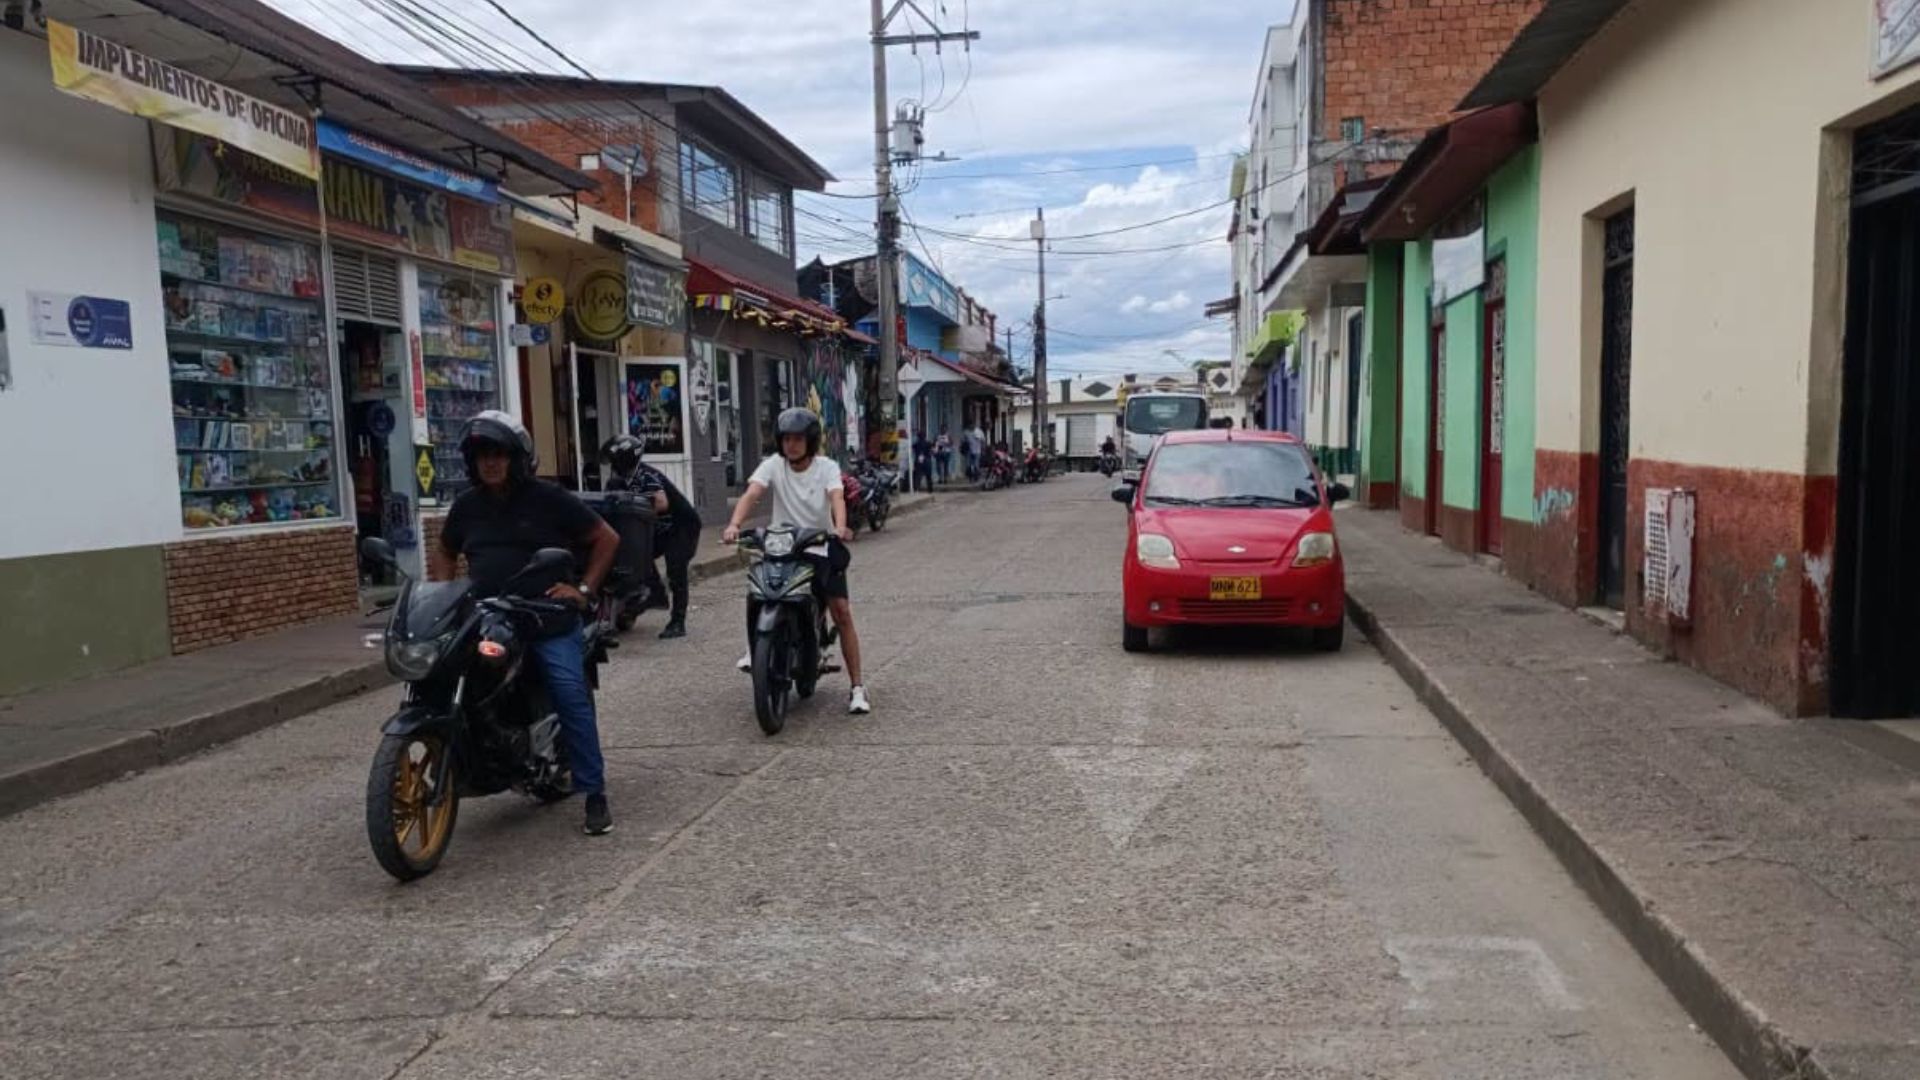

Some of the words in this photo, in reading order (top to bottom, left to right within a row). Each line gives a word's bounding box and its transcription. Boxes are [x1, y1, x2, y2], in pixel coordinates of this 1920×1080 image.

[78, 31, 221, 112] IMPLEMENTOS
[223, 89, 246, 118] DE
[251, 102, 308, 146] OFICINA
[526, 303, 557, 319] efecty
[1237, 579, 1258, 592] 621
